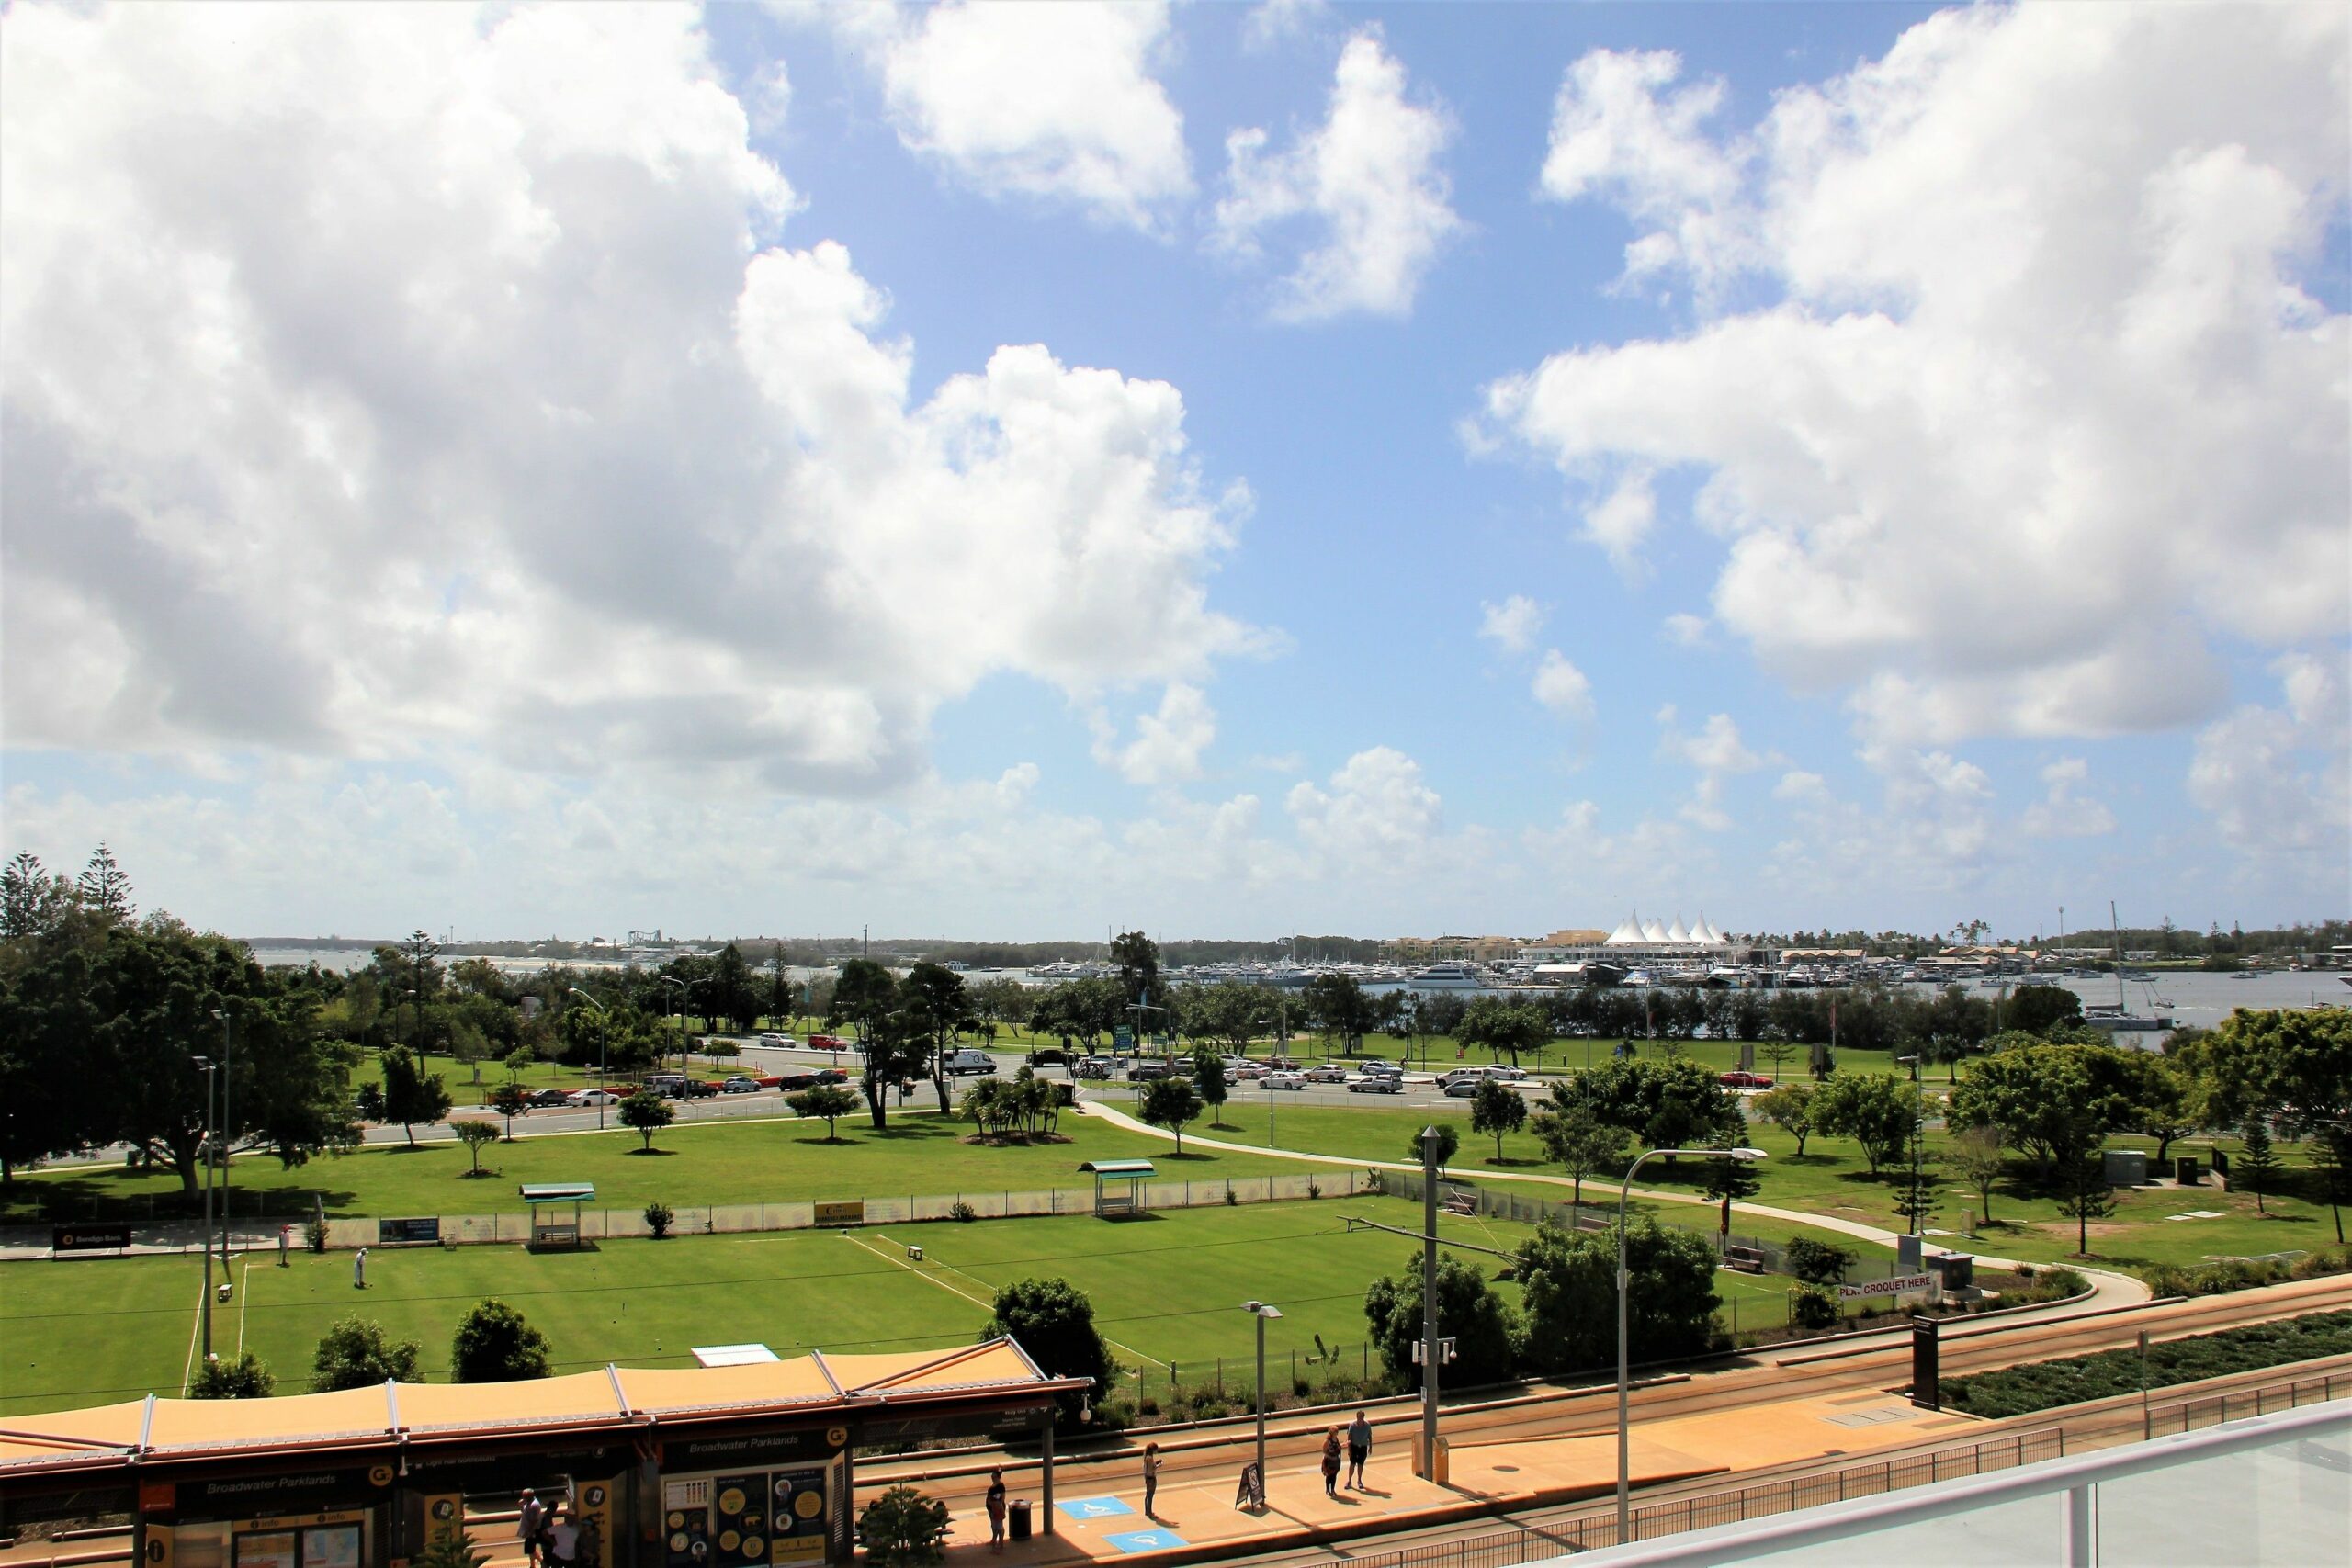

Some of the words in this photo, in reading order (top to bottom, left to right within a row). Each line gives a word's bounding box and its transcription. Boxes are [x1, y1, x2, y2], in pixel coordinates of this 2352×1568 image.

[1839, 1287, 1860, 1297] PLA
[1863, 1280, 1905, 1294] CROQUET
[1908, 1276, 1931, 1288] HERE
[689, 1441, 748, 1454] Broadwater
[750, 1435, 799, 1449] Parklands
[206, 1480, 276, 1495] Broadwater
[279, 1472, 337, 1490] Parklands
[261, 1518, 279, 1528] info
[327, 1513, 345, 1522] info
